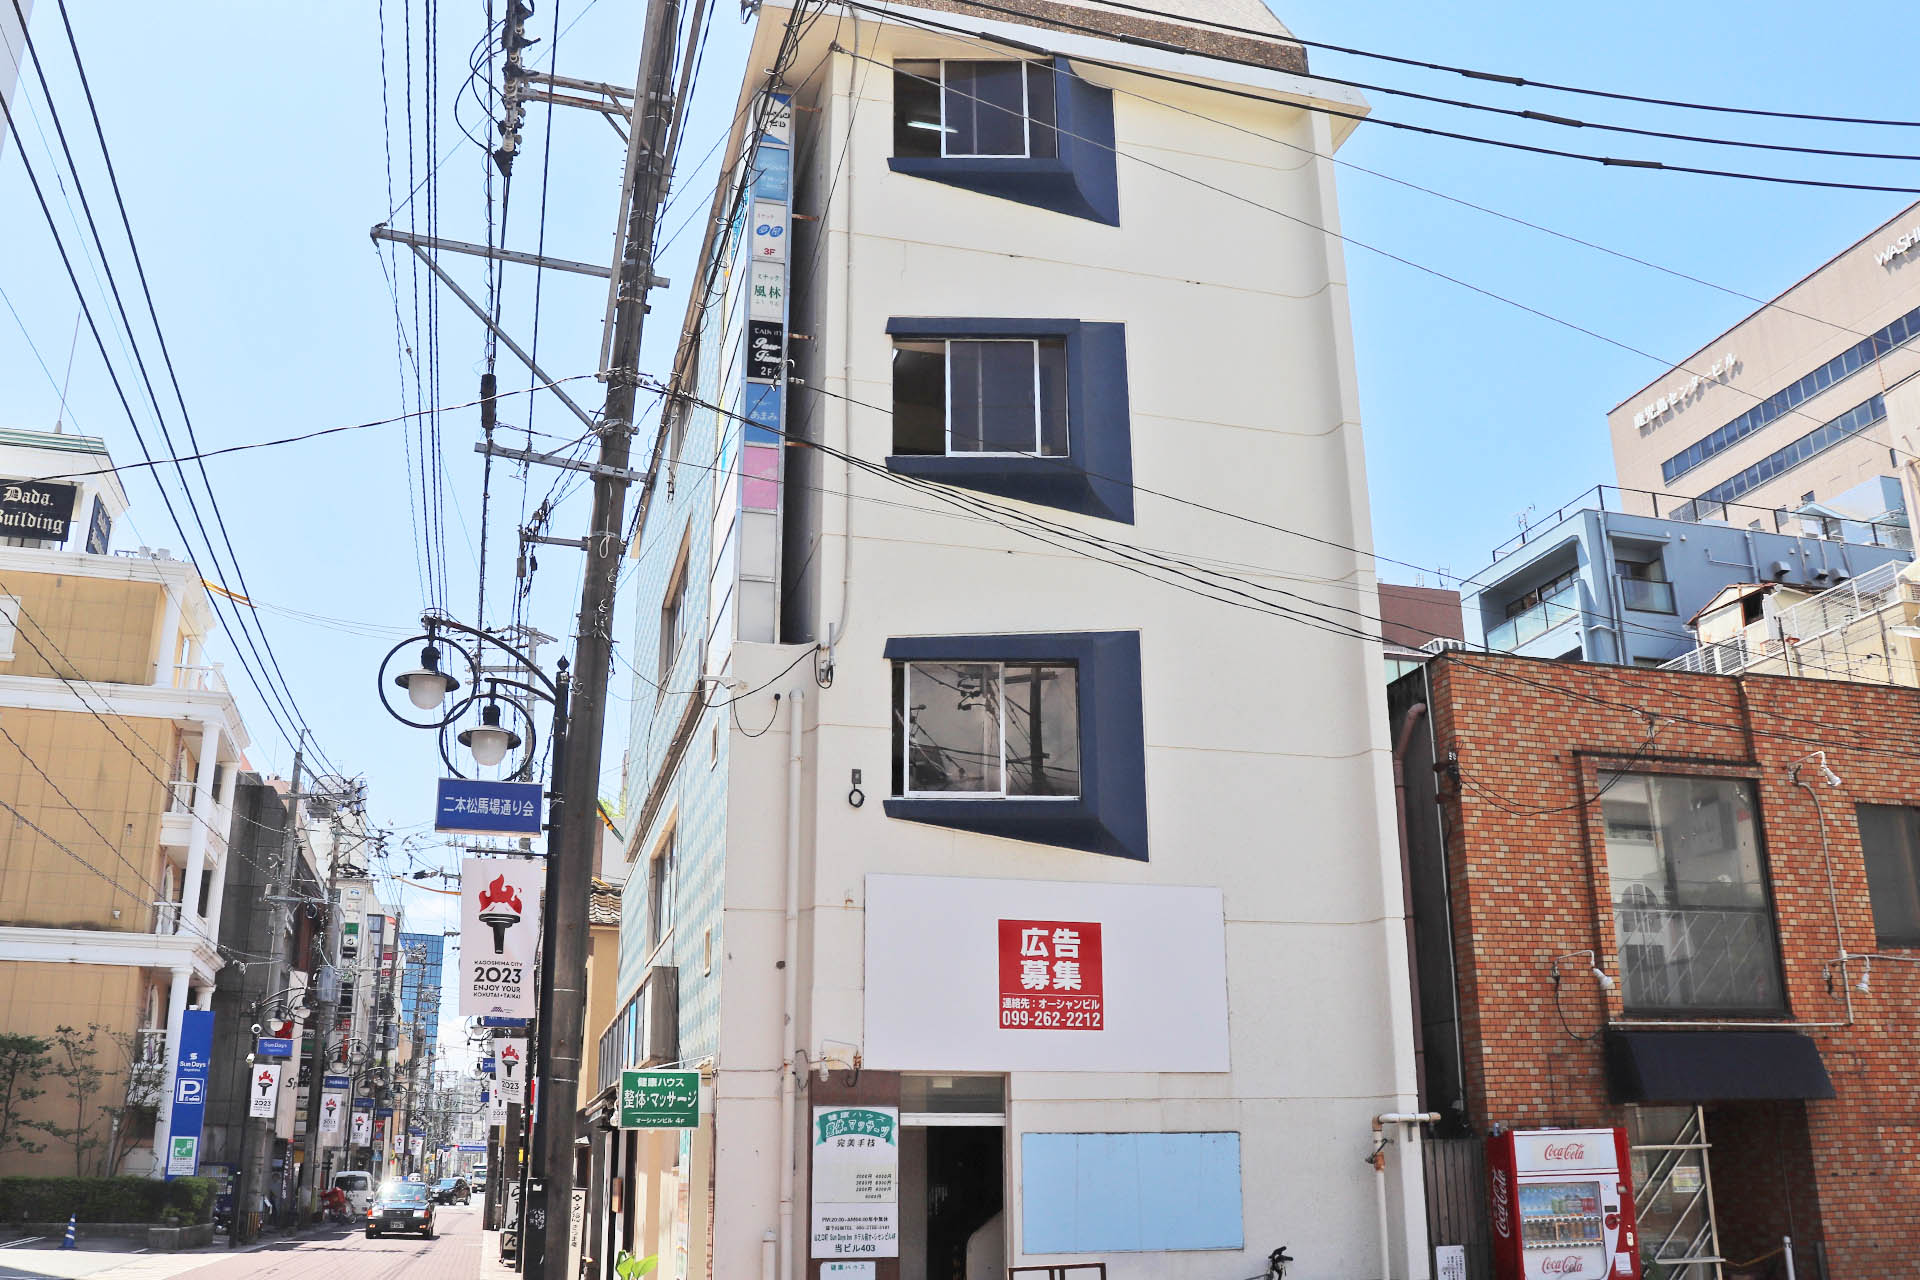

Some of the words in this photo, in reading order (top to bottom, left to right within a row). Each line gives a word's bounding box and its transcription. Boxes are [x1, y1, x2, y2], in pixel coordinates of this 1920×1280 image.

[763, 247, 776, 256] 3F
[754, 284, 781, 299] 風林
[760, 366, 773, 376] 2F
[443, 796, 534, 817] 二本松馬場通り会
[1020, 927, 1081, 959] 広告
[474, 967, 522, 984] 2023
[1020, 960, 1082, 991] 募集
[1002, 1010, 1101, 1027] 099-262-2212
[501, 1081, 520, 1090] 2023
[637, 1077, 685, 1087] 健康ハウス
[179, 1080, 201, 1102] P
[835, 1244, 877, 1253] 当ビル403
